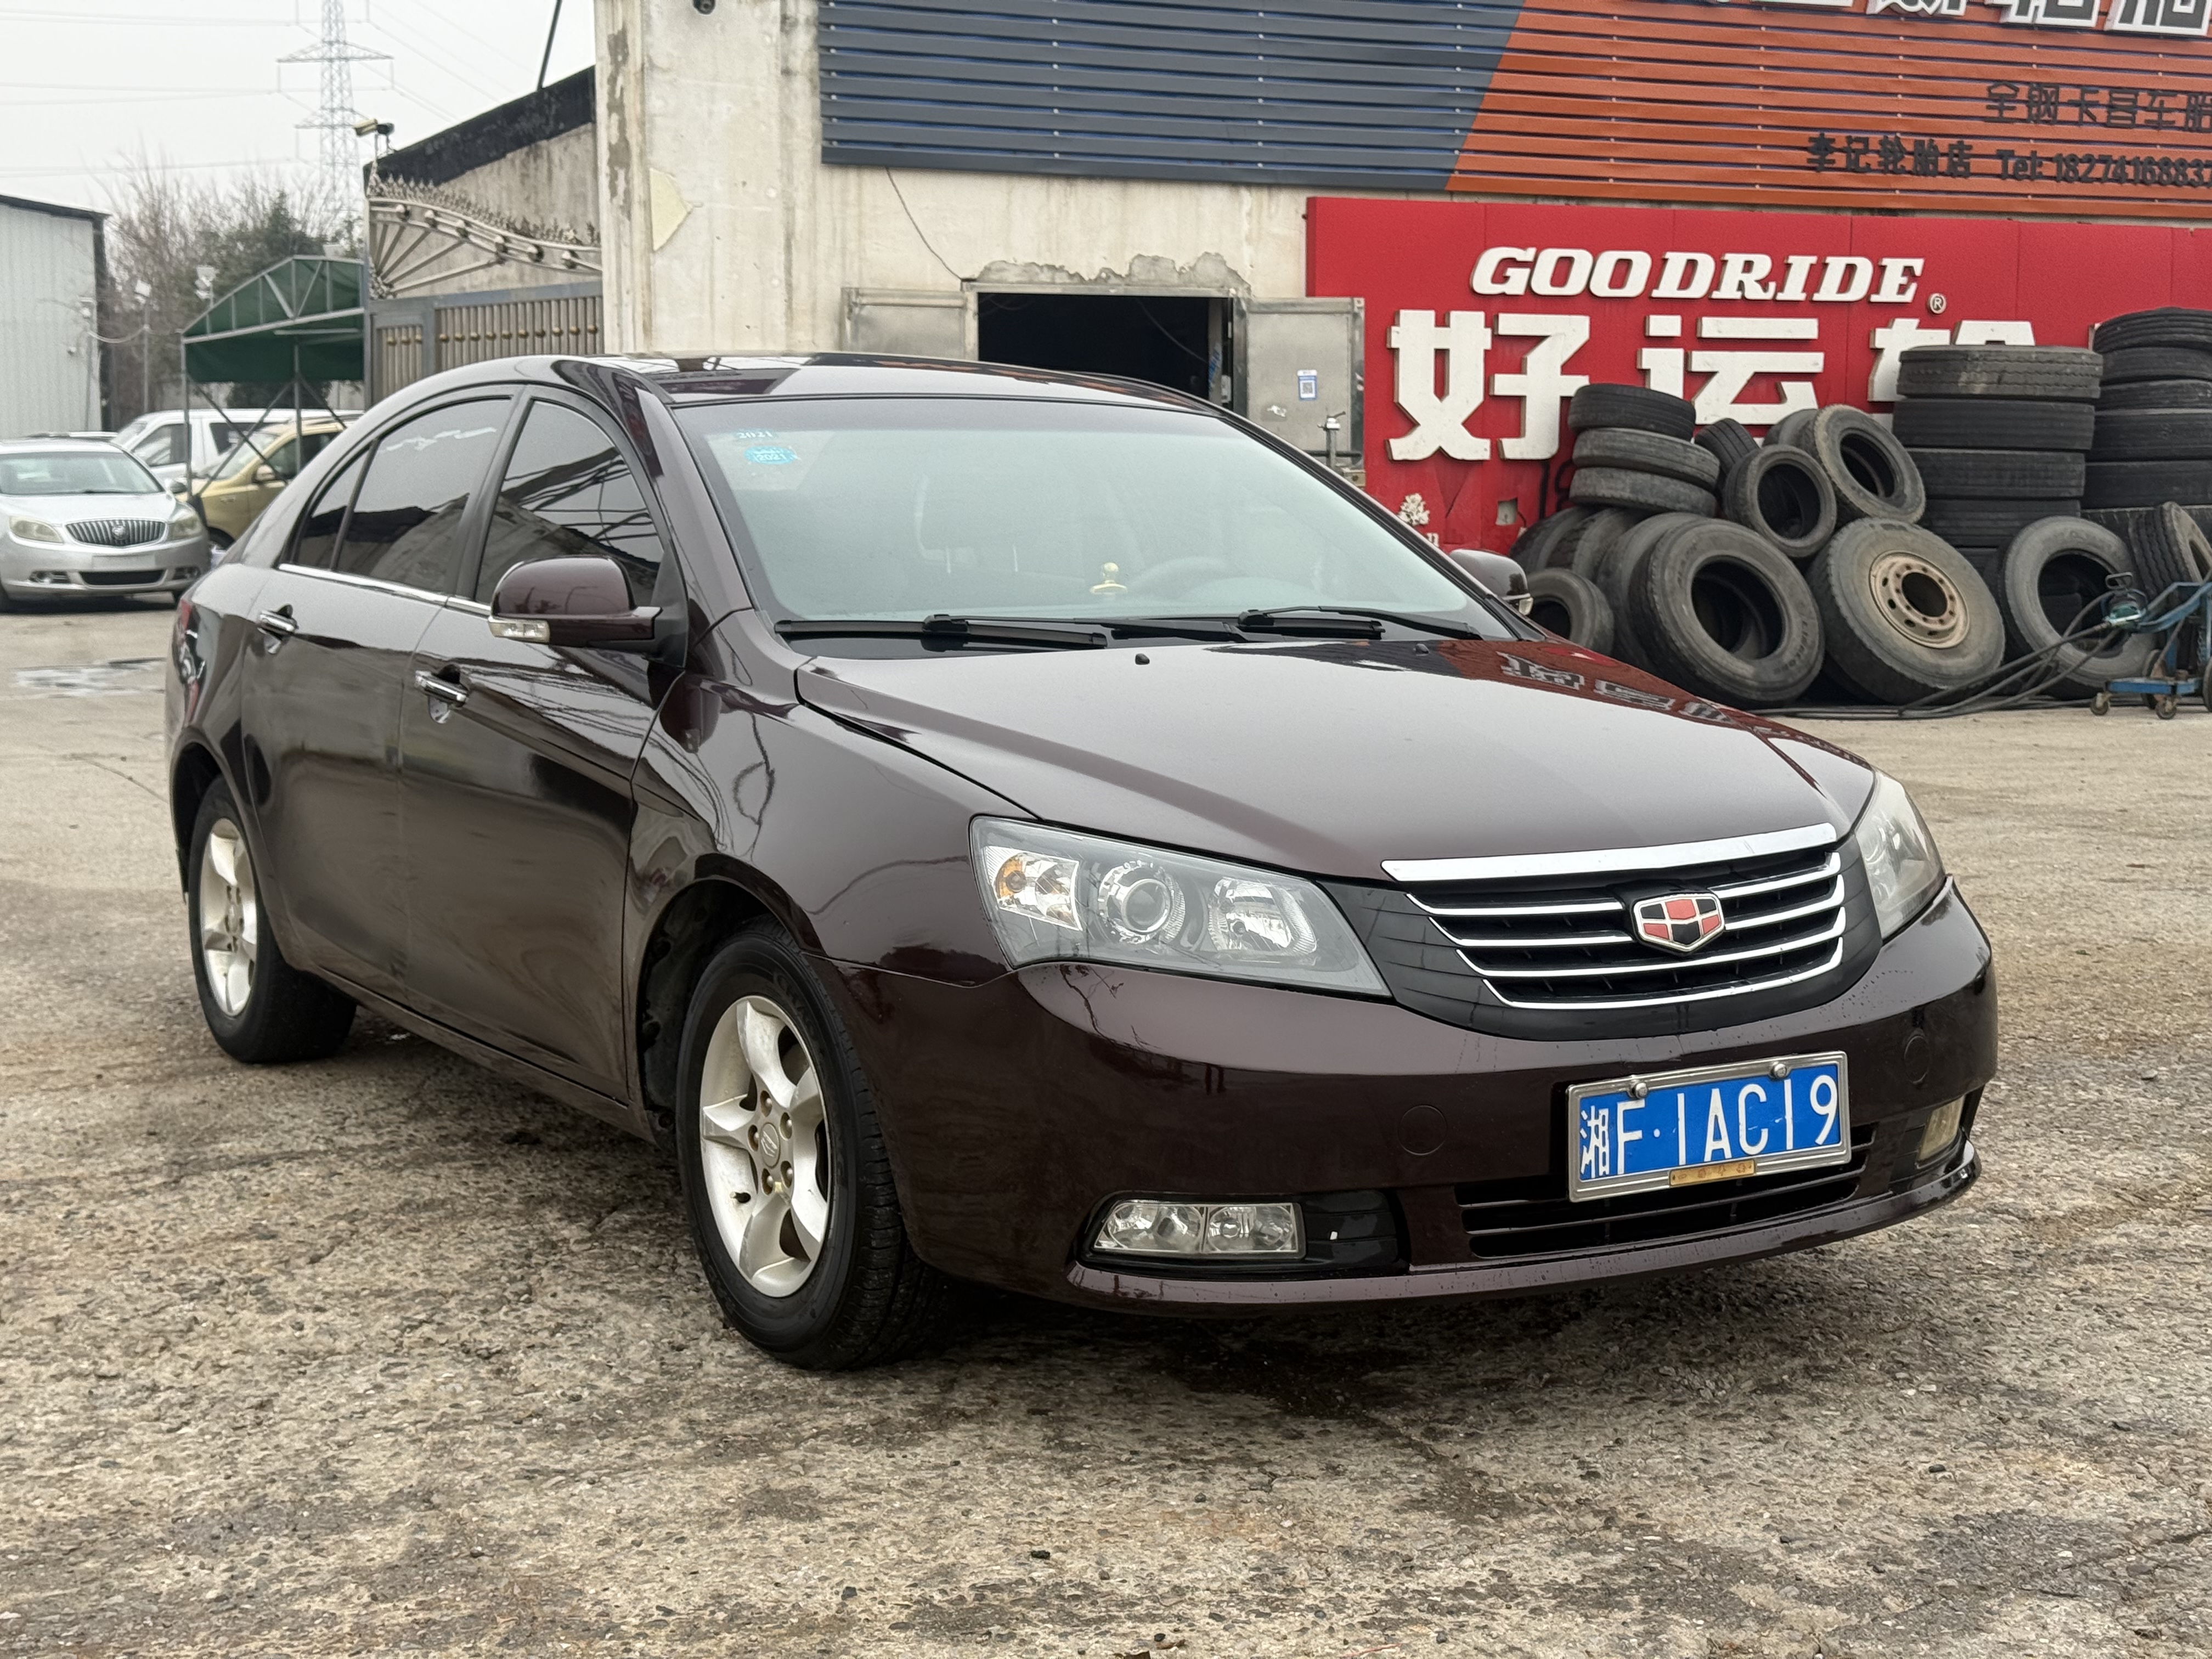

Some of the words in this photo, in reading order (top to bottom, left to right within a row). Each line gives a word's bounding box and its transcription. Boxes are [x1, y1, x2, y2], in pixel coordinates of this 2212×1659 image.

[1807, 132, 1973, 178] 李记轮胎店
[1470, 246, 1925, 304] GOODRIDE
[1580, 1074, 1838, 1179] 湘F·1AC19
